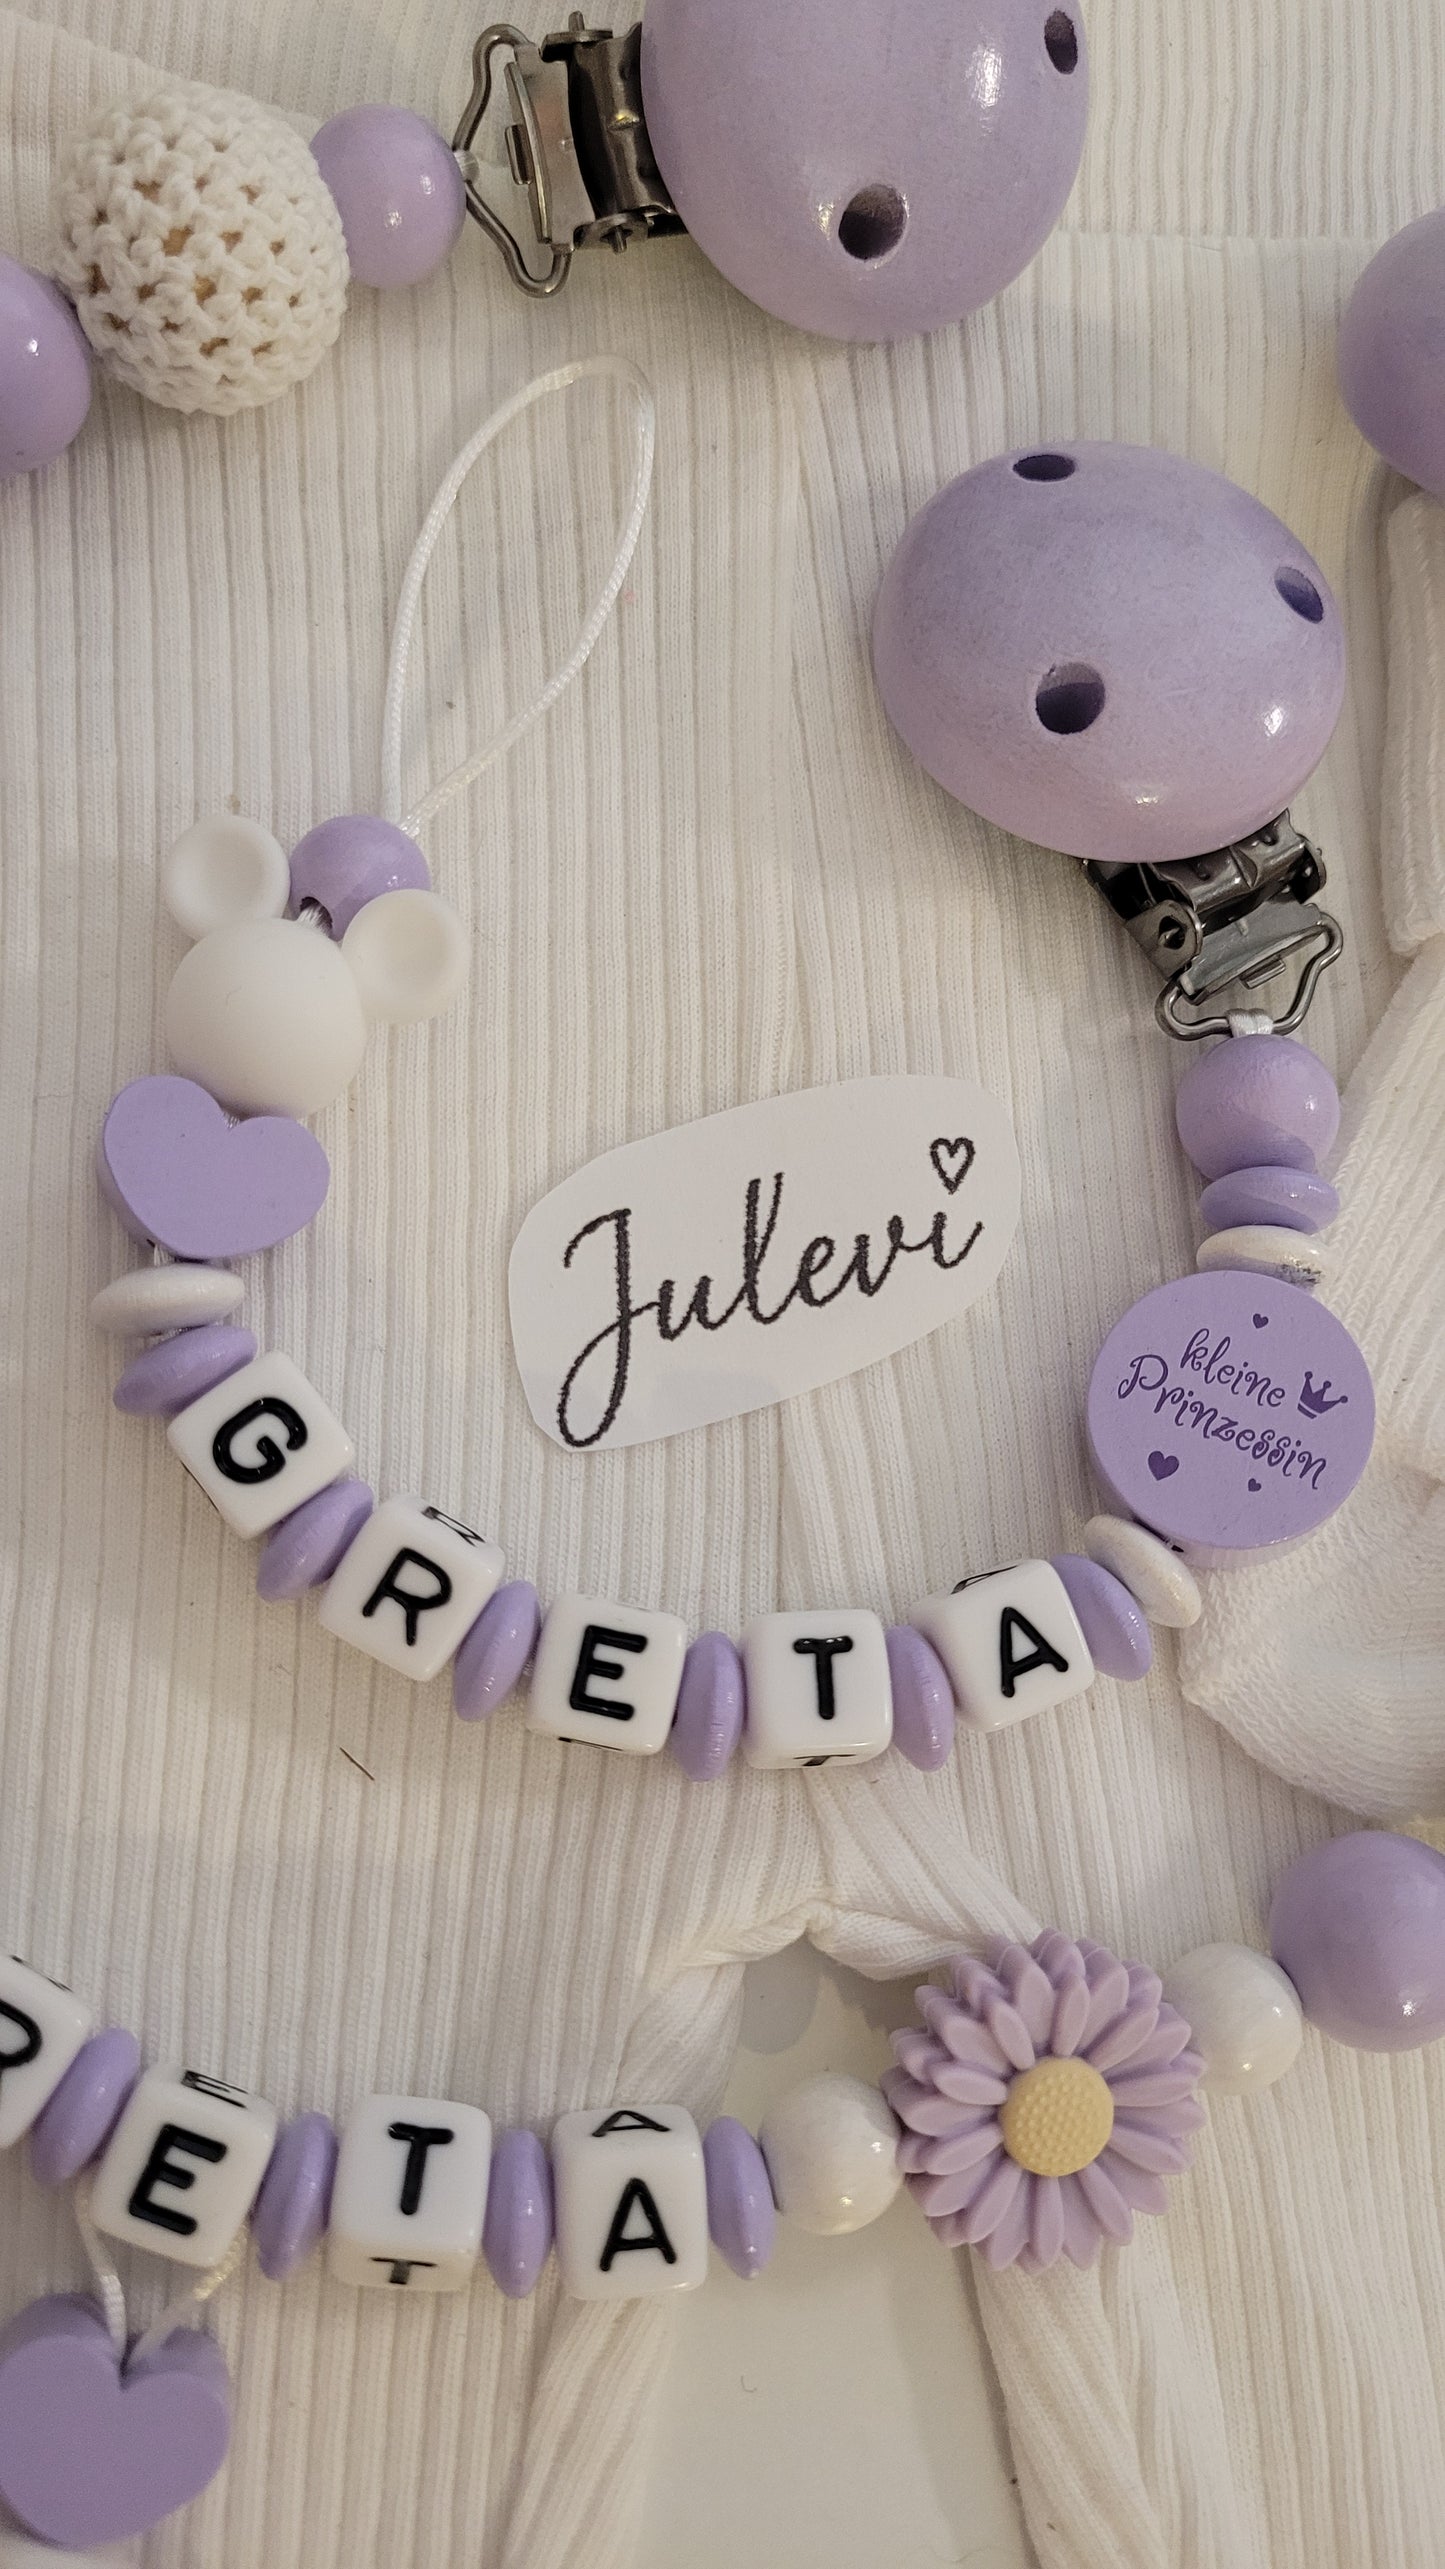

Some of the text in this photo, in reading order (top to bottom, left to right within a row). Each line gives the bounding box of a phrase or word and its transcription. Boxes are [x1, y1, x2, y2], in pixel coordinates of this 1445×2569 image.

[557, 1136, 983, 1447] Julevi
[1180, 1328, 1285, 1407] kleine
[1117, 1354, 1327, 1490] Prinzessin
[212, 1397, 1069, 1721] GRETA
